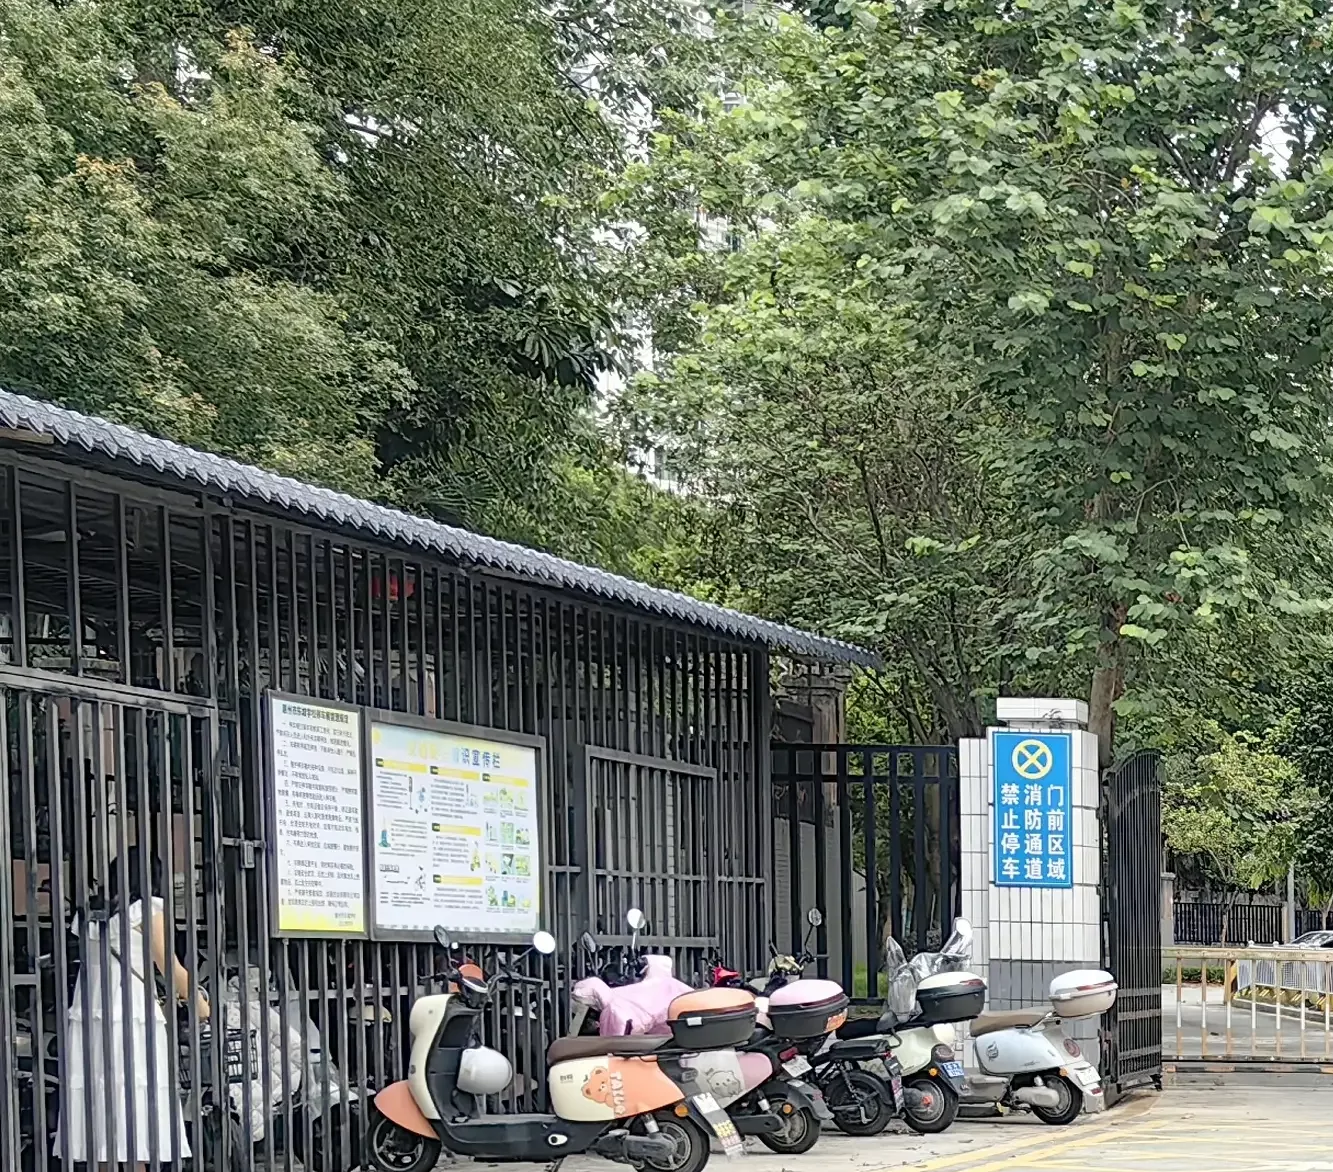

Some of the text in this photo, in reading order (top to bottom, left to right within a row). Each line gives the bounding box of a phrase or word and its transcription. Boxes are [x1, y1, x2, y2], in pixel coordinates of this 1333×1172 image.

[1001, 782, 1021, 880] 禁止停车
[1023, 784, 1043, 881] 消防通道
[1046, 784, 1066, 881] 门前区域
